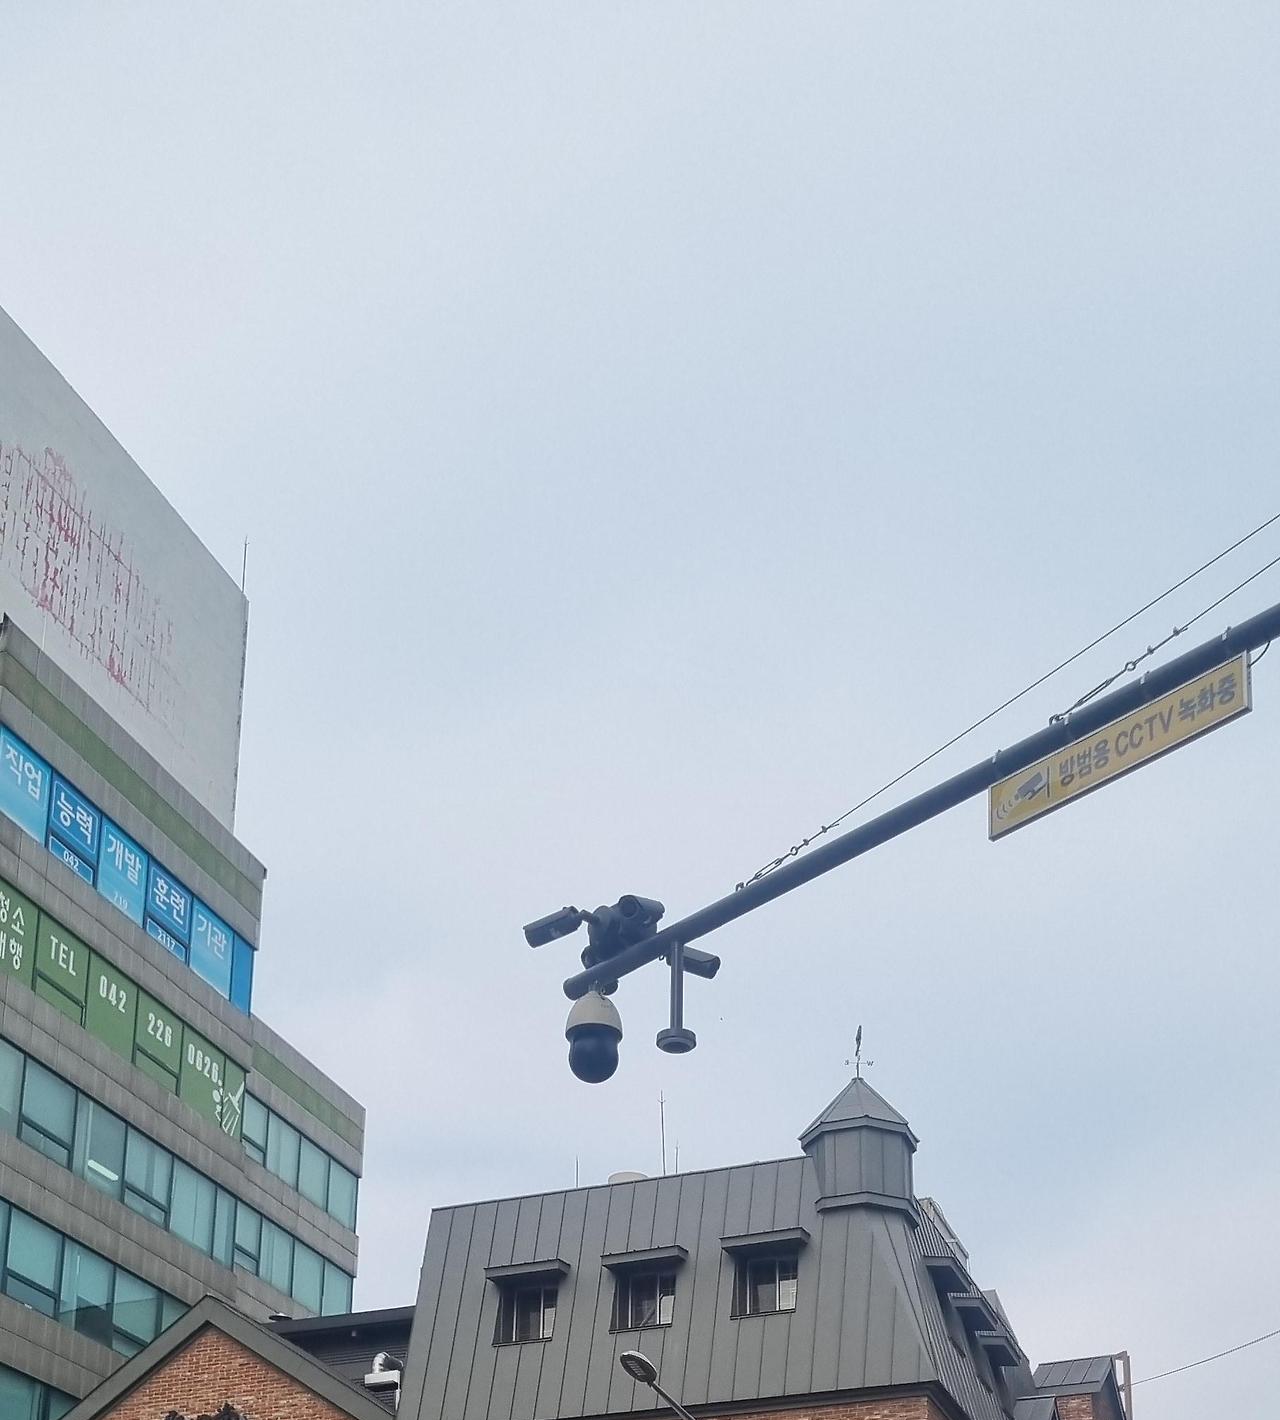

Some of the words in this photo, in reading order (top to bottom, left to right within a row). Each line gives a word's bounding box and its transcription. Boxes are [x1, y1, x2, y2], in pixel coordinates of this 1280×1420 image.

[1059, 739, 1110, 787] 방범용
[1115, 704, 1174, 758] CCTV
[1178, 672, 1237, 722] 녹화중
[5, 742, 41, 800] 직업
[57, 792, 94, 844] 능력
[107, 833, 142, 886] 개발
[154, 876, 185, 925] 훈련
[197, 907, 227, 959] 기관
[63, 850, 80, 872] 042
[50, 935, 76, 977] TEL
[100, 975, 127, 1014] 042
[147, 1013, 172, 1047] 226
[188, 1043, 219, 1085] 0626
